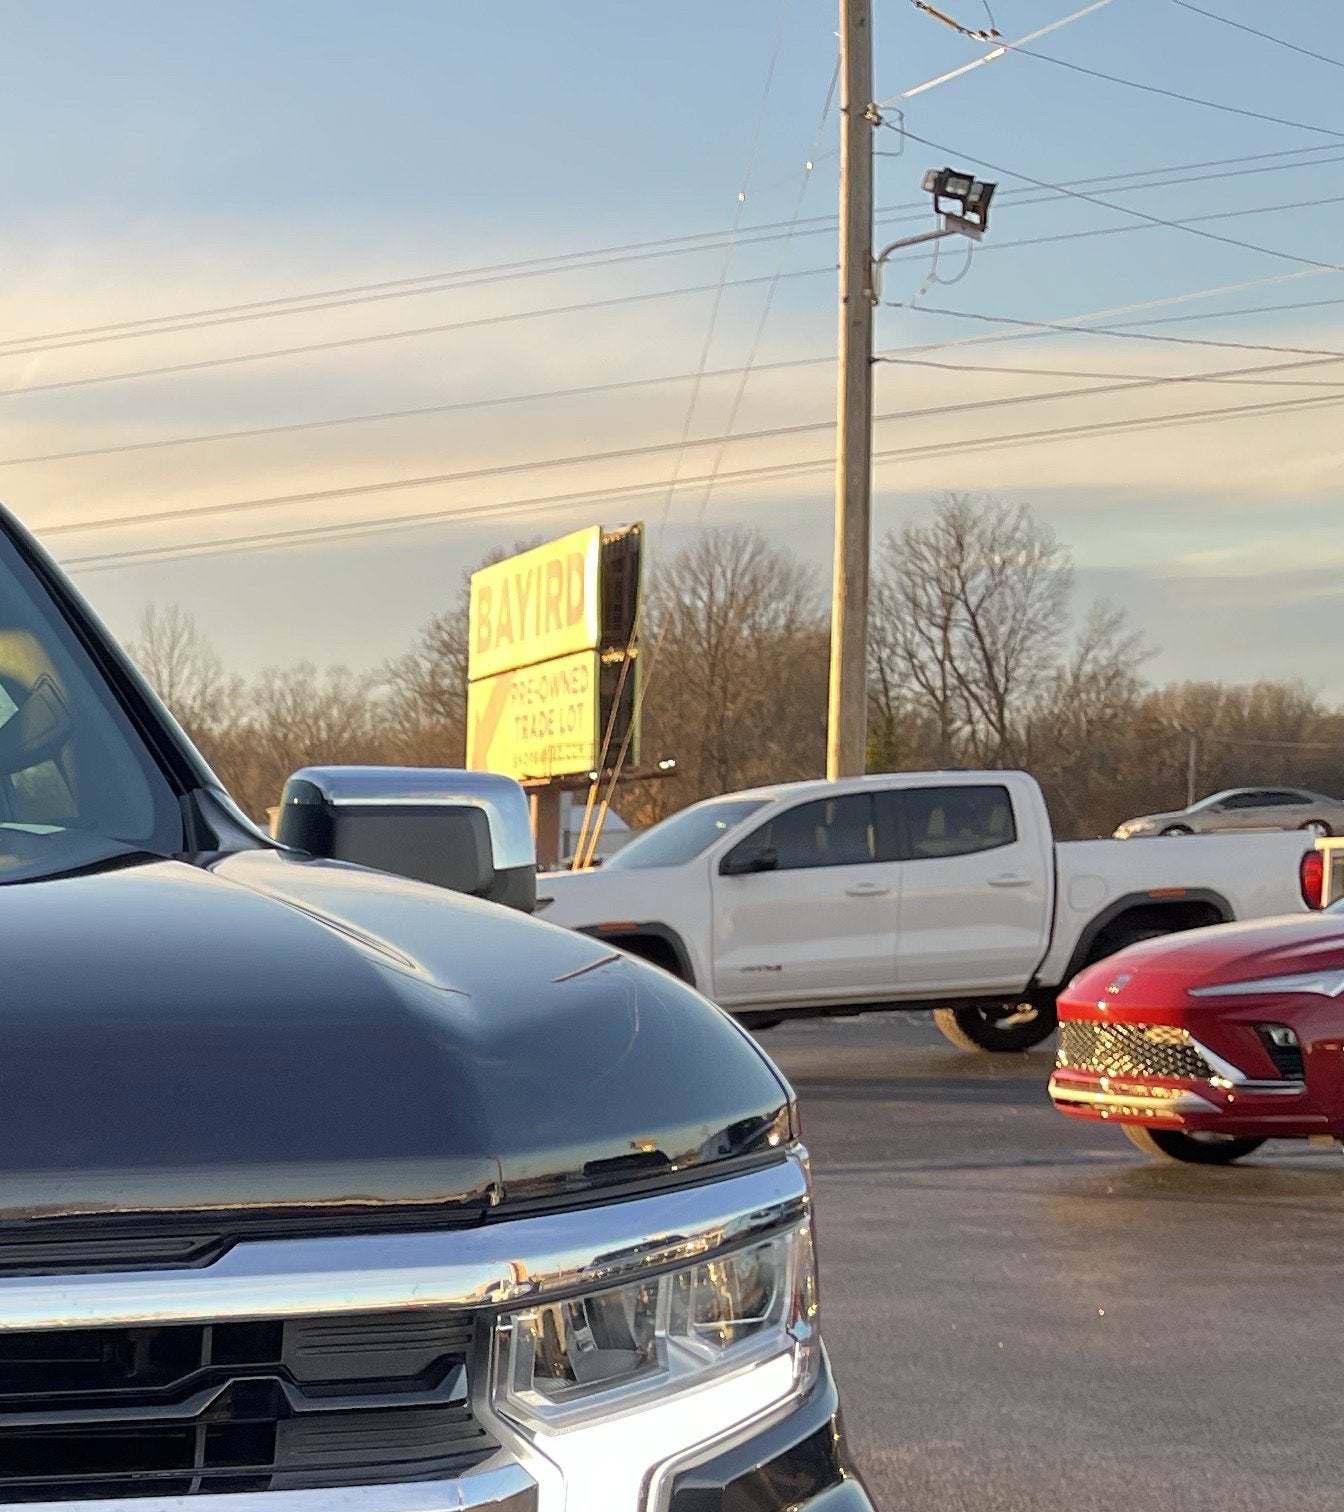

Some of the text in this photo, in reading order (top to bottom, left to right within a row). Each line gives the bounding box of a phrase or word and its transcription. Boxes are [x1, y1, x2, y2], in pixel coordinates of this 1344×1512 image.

[476, 552, 585, 654] BAYIRD
[514, 702, 584, 743] TRADE LOT
